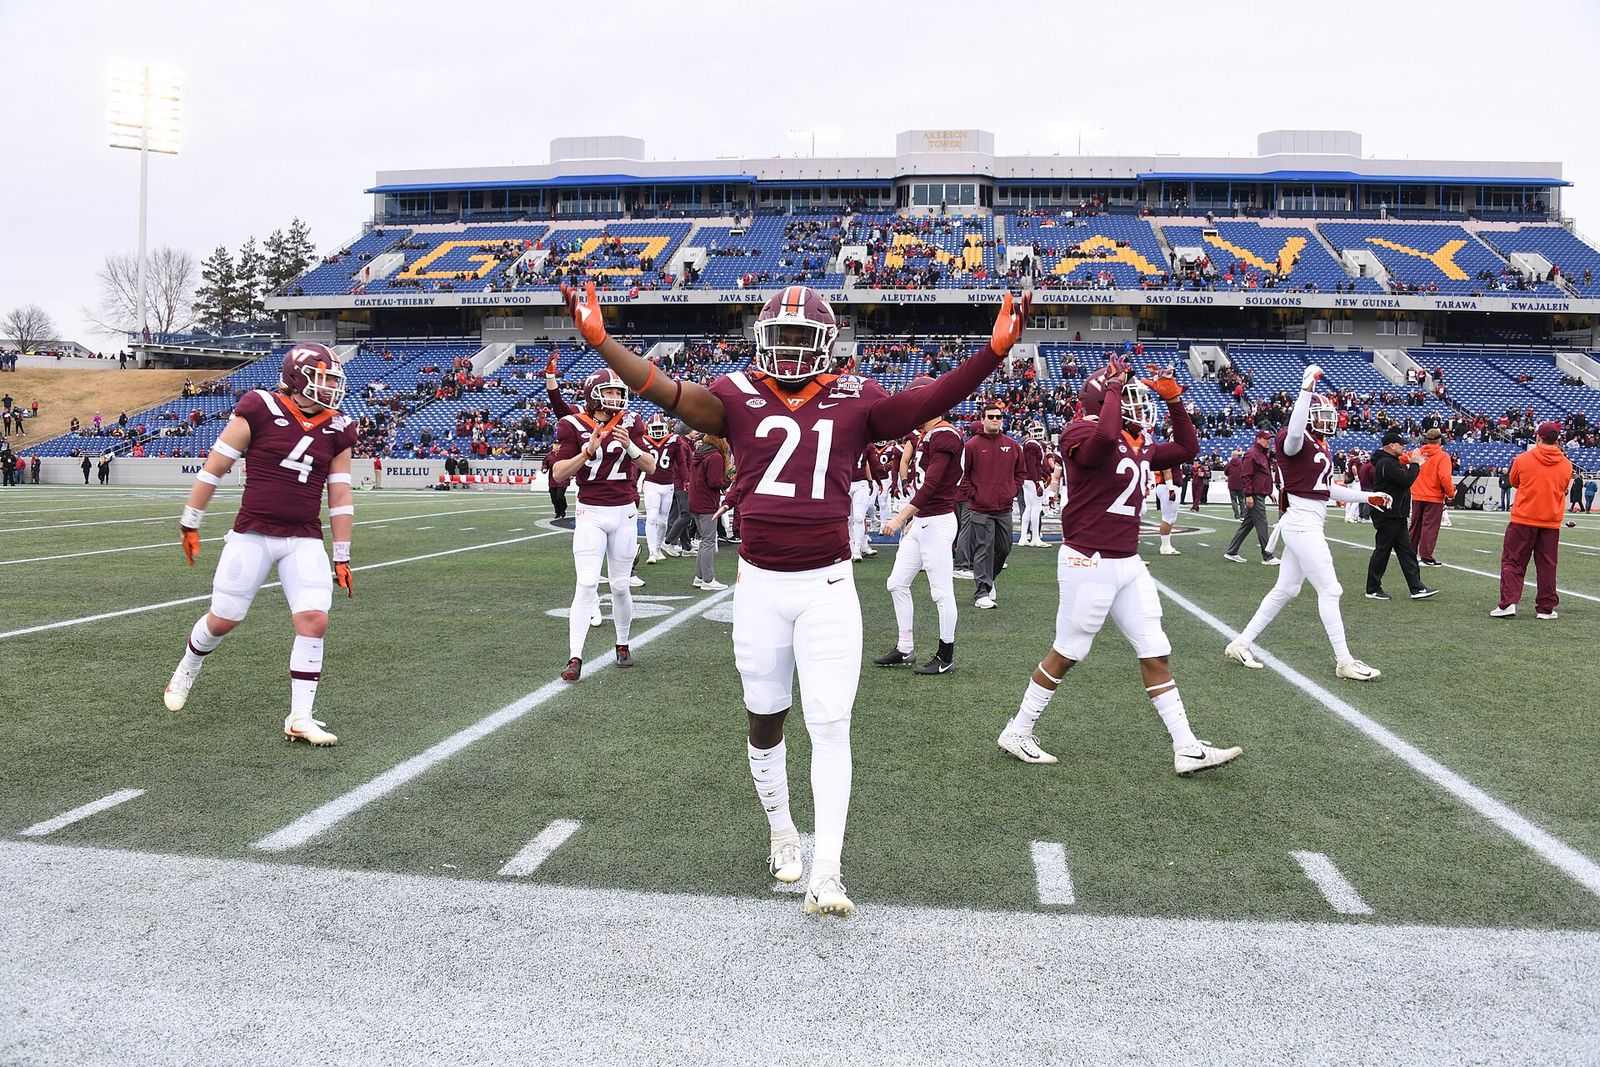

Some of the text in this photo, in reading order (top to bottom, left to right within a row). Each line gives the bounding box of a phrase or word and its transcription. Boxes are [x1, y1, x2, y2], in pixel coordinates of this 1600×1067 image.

[922, 130, 967, 139] AKERSON
[928, 140, 960, 148] TOWER
[461, 296, 531, 305] BELLEAU WOOD
[662, 294, 689, 302] WAKE
[718, 294, 763, 302] JAVA SEA
[831, 293, 849, 301] SEA
[881, 294, 937, 302] ALEUTIANS
[1042, 294, 1114, 302] GUADALCANAL
[1146, 295, 1214, 304] SAVO ISLAND
[1245, 297, 1302, 305] SOLOMONS
[354, 298, 435, 306] CHATEAU-THIERRY
[1335, 298, 1400, 308] NEW GUINEA
[1435, 300, 1477, 309] TARAWA
[1511, 302, 1569, 311] KWAJALEIN
[787, 398, 804, 407] VT
[280, 435, 315, 484] 4
[581, 440, 627, 481] 92
[754, 415, 834, 500] 21
[387, 467, 430, 476] PELELIU
[469, 468, 503, 476] LEYTE
[1067, 556, 1099, 568] TECH
